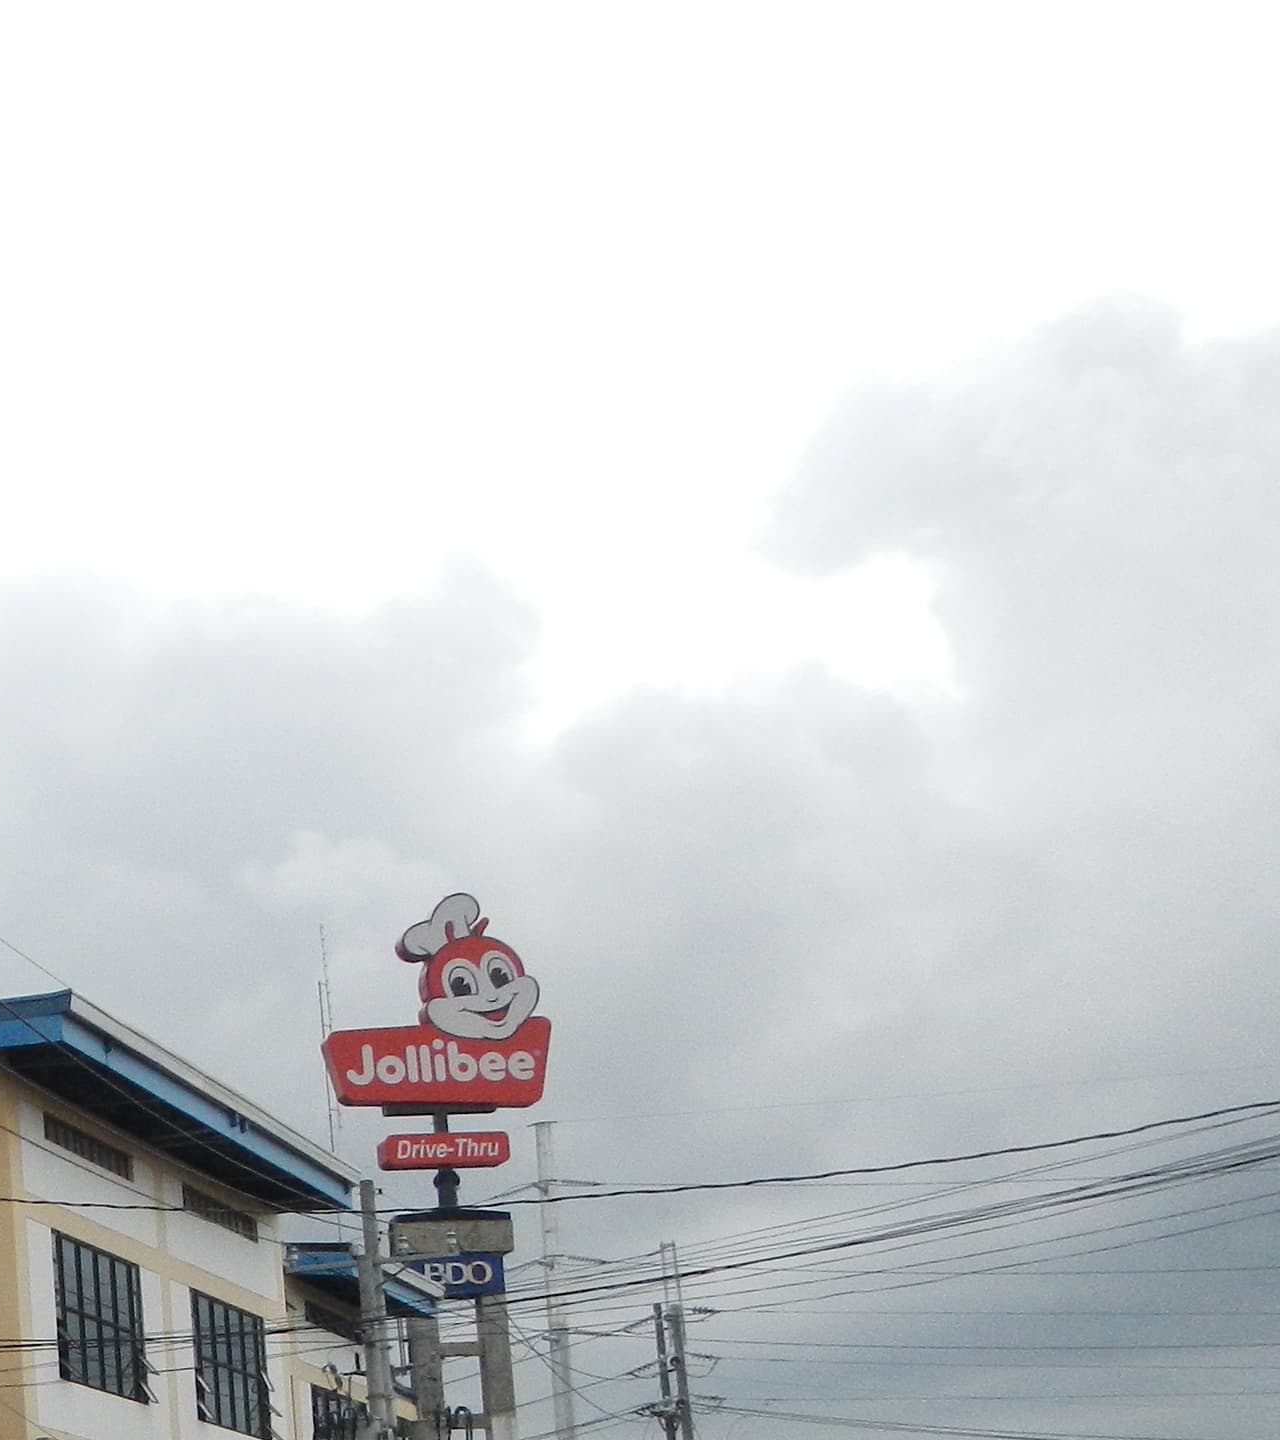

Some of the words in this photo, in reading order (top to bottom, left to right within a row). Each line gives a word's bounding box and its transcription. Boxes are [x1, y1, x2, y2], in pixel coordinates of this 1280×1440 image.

[346, 1039, 535, 1086] Jollibee
[397, 1138, 499, 1161] Drive-Thru
[424, 1261, 493, 1286] BDO
